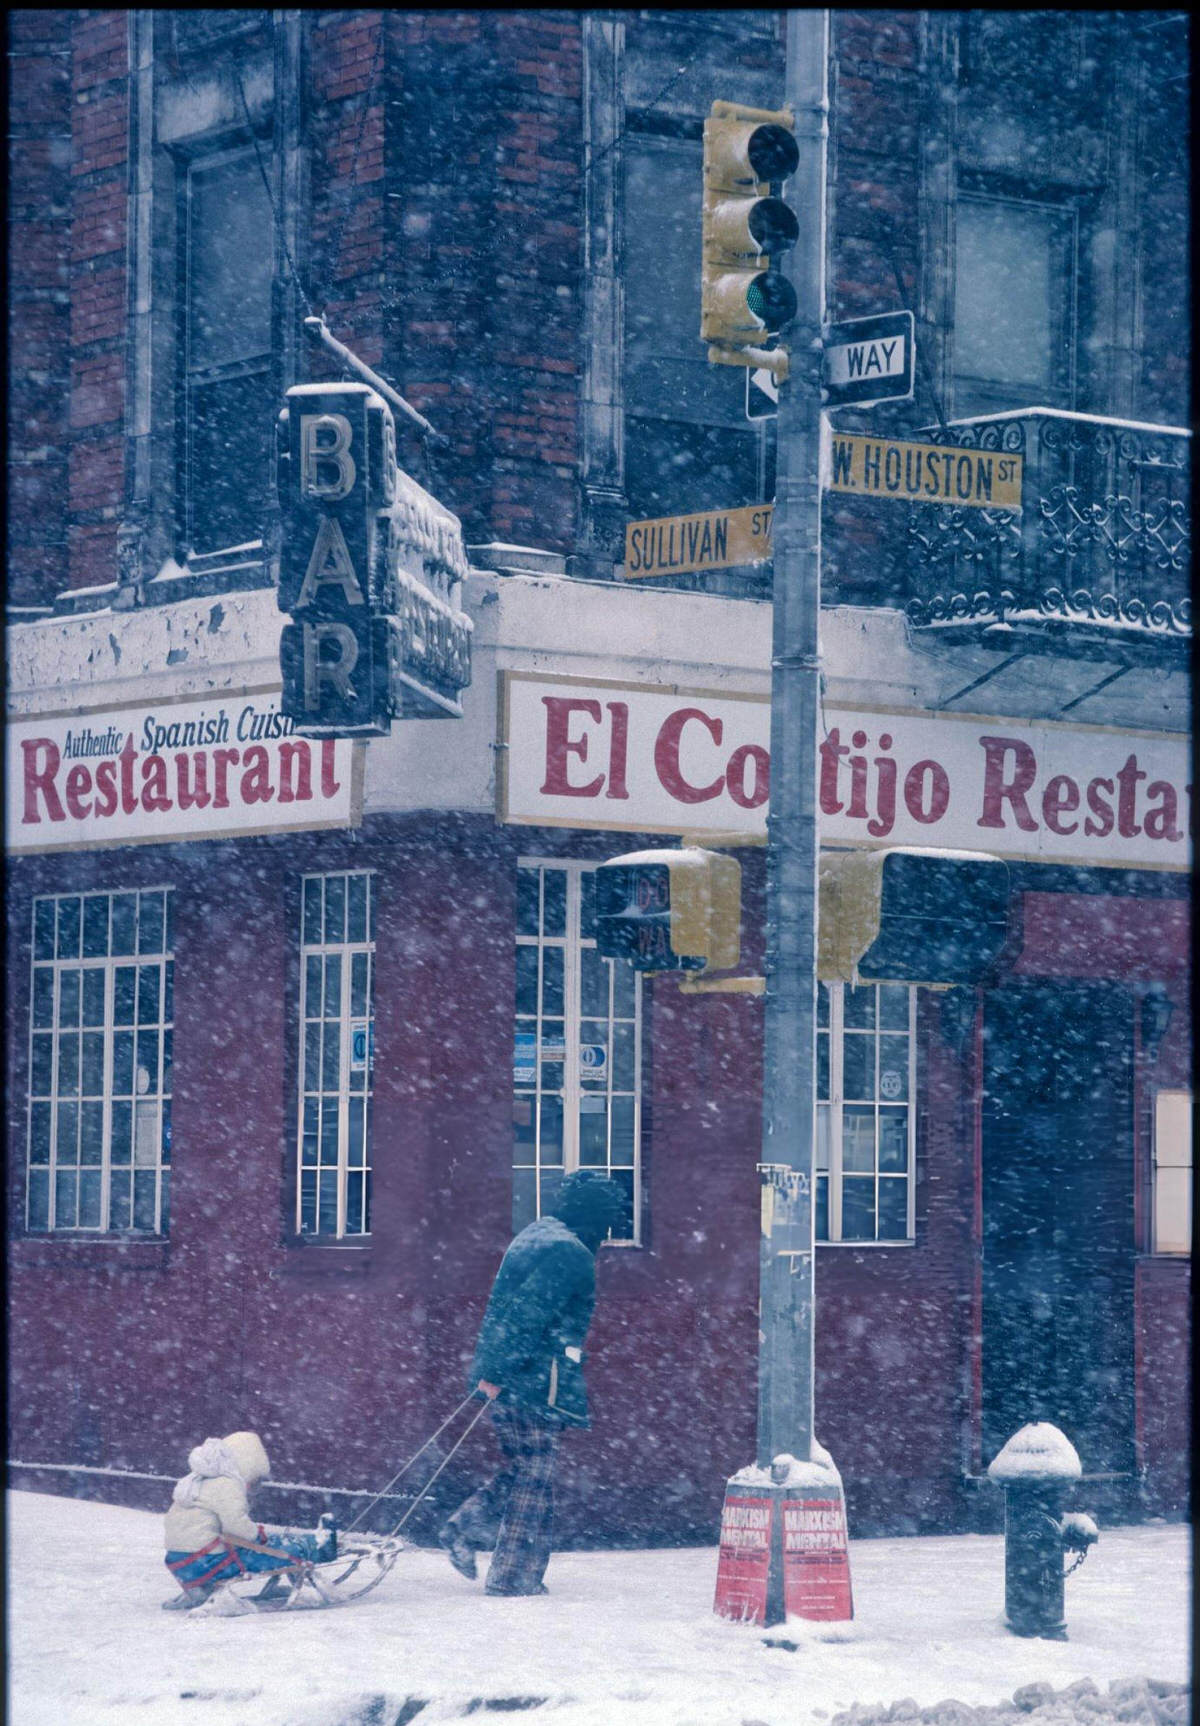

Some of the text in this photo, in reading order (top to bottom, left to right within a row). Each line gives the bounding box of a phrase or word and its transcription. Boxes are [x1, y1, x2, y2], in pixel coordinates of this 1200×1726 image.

[847, 341, 897, 378] WAY
[832, 439, 1017, 501] W. HOUSTON ST
[298, 413, 365, 711] BAR
[630, 510, 771, 571] SULLIVAN ST
[62, 727, 124, 760] Authentic
[141, 710, 229, 755] Spanish
[20, 732, 341, 825] Restaurant
[539, 695, 1193, 843] El Cotijo Resta
